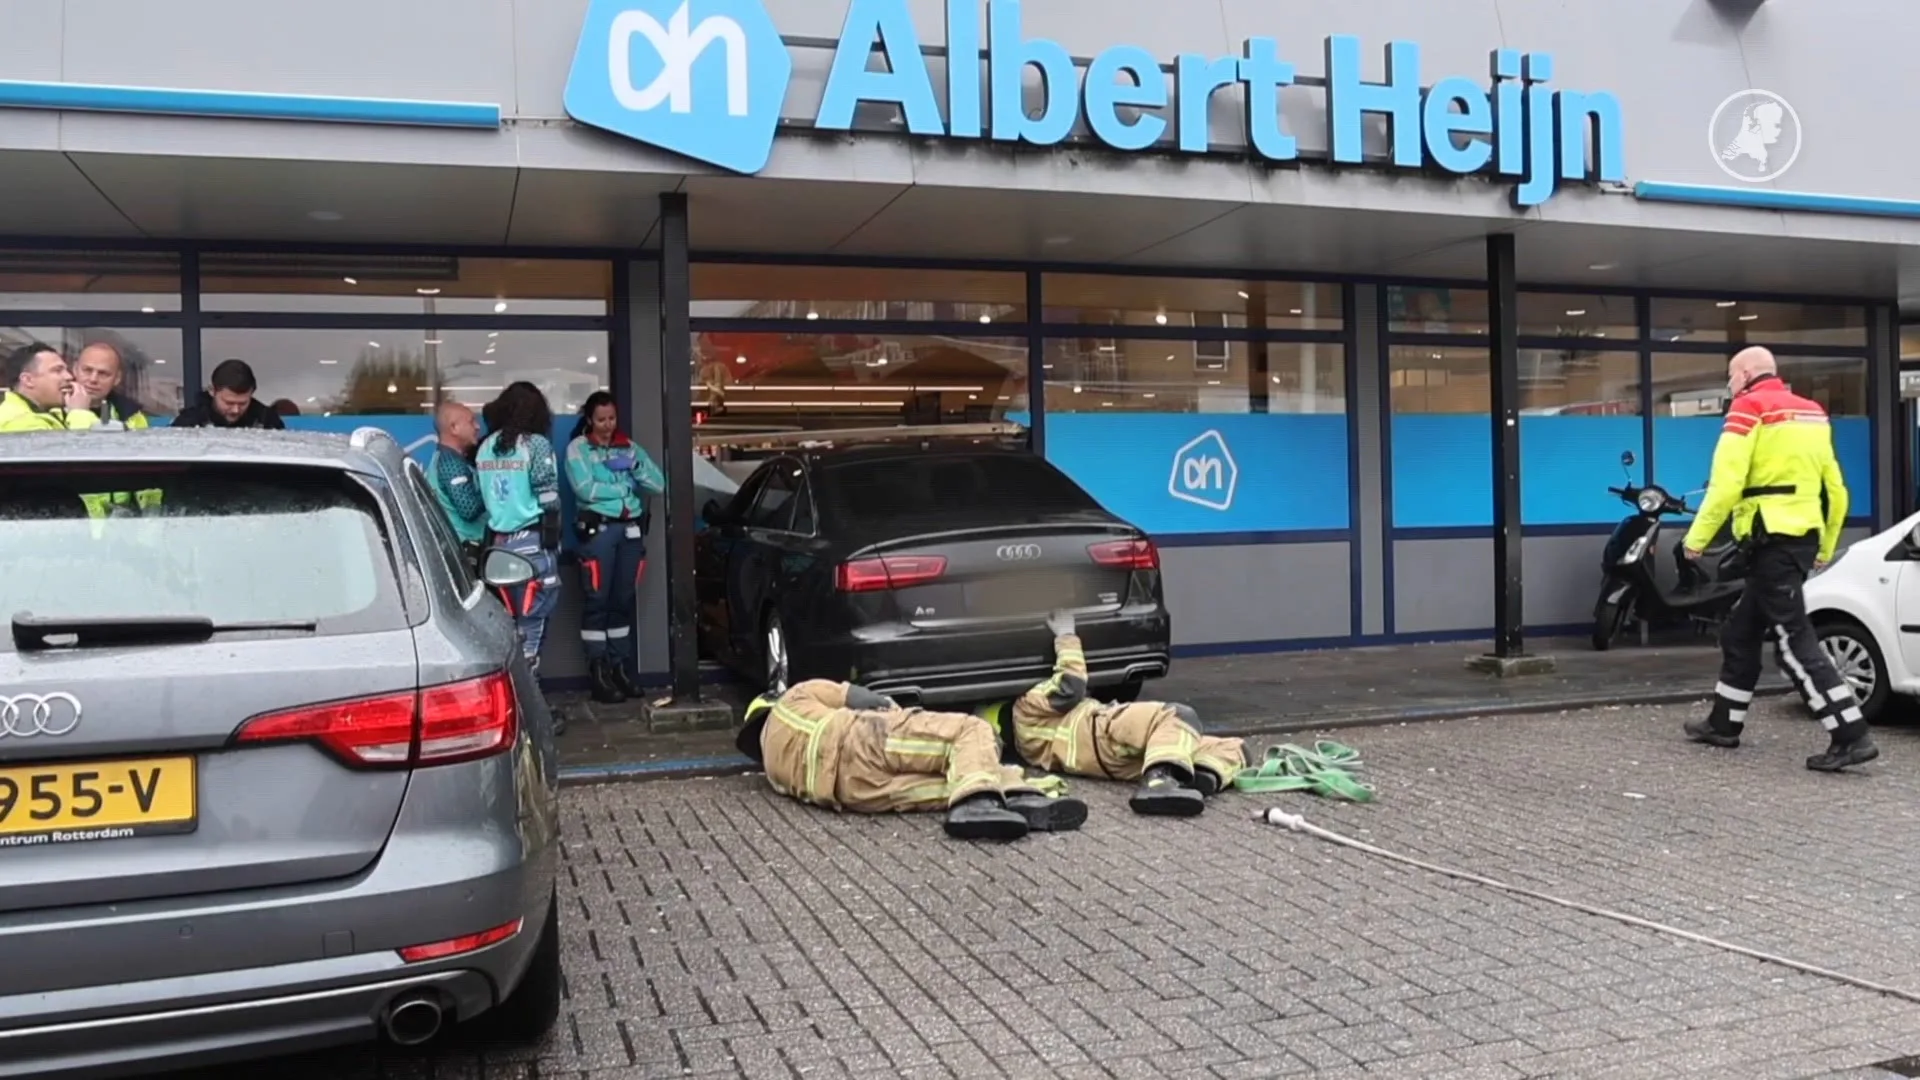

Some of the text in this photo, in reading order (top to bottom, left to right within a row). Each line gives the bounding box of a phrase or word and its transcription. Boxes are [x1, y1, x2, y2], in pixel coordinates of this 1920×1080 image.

[815, 0, 1625, 205] Albert Heijn
[52, 826, 134, 843] Rotterdam
